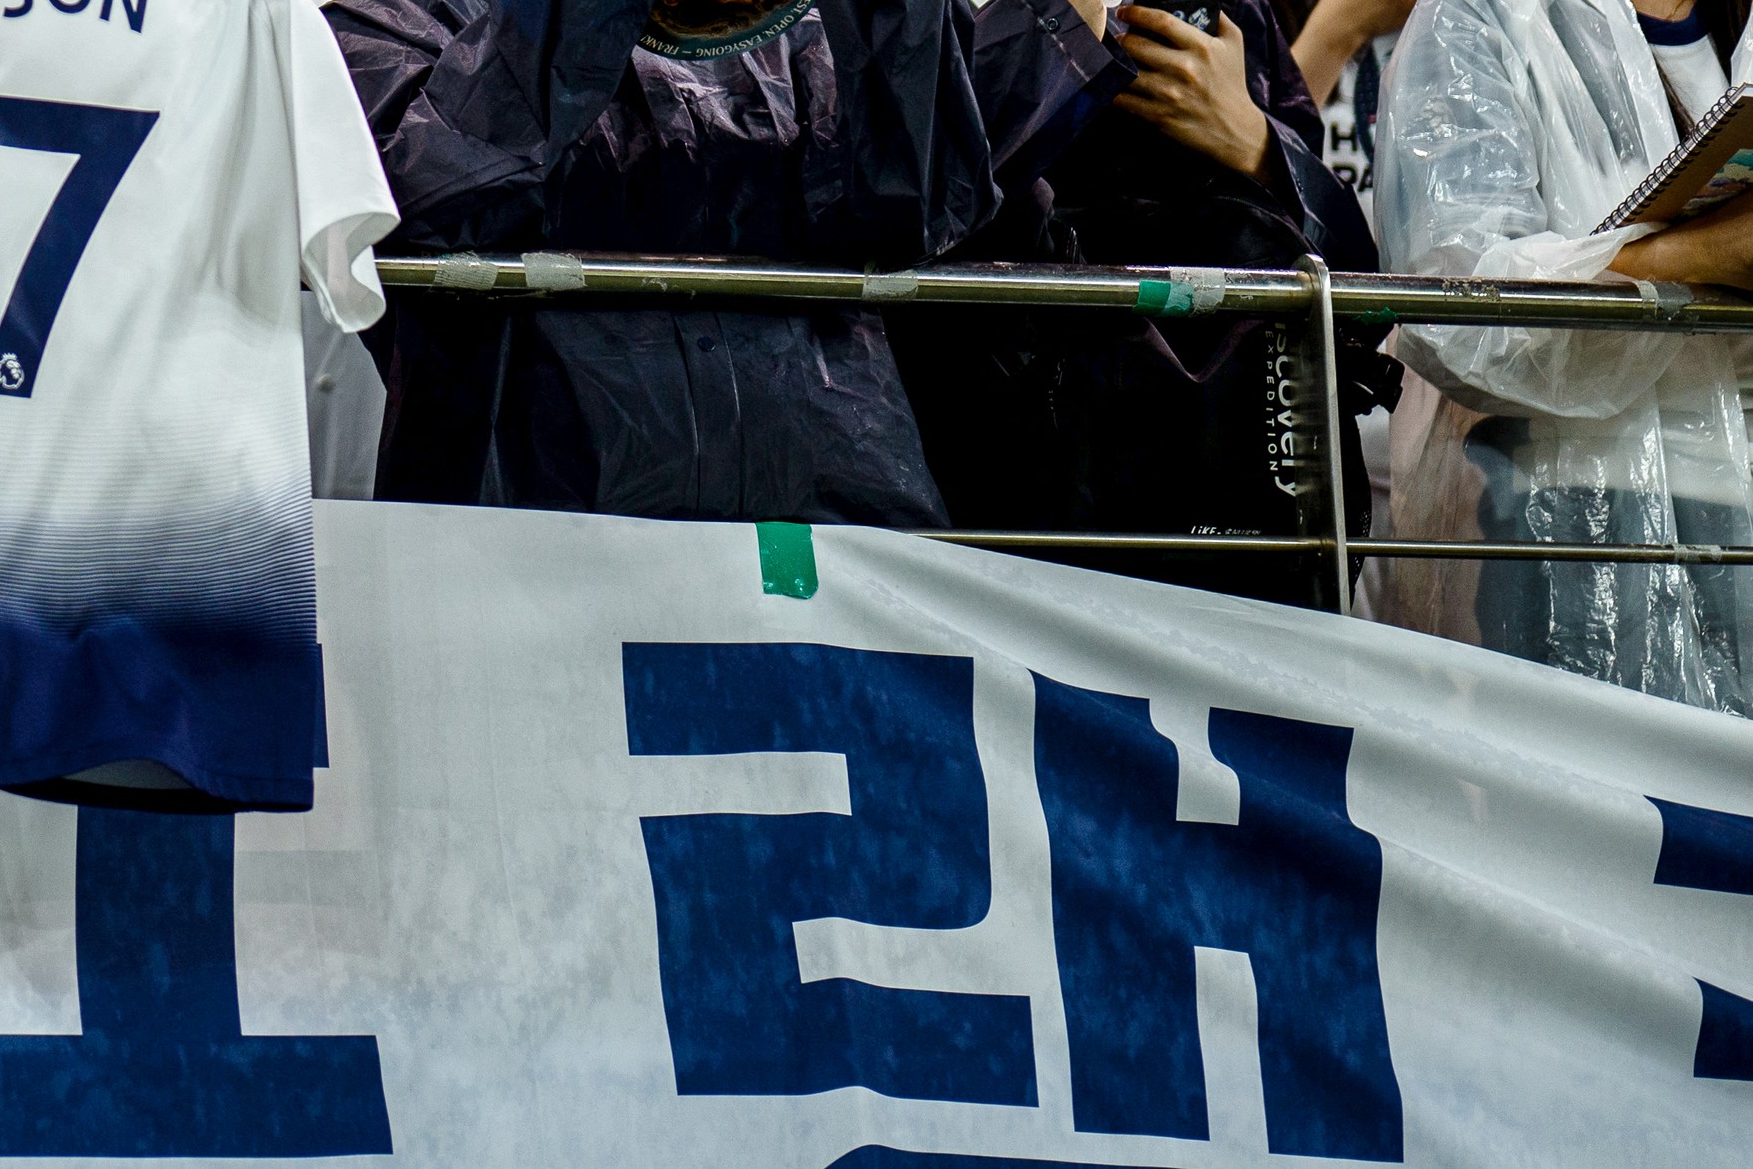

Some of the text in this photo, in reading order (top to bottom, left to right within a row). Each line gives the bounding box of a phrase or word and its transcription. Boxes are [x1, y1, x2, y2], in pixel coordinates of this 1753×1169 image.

[640, 33, 680, 56] FRANK!
[695, 34, 763, 58] EASYGOING
[1265, 330, 1279, 471] EXPEDITION
